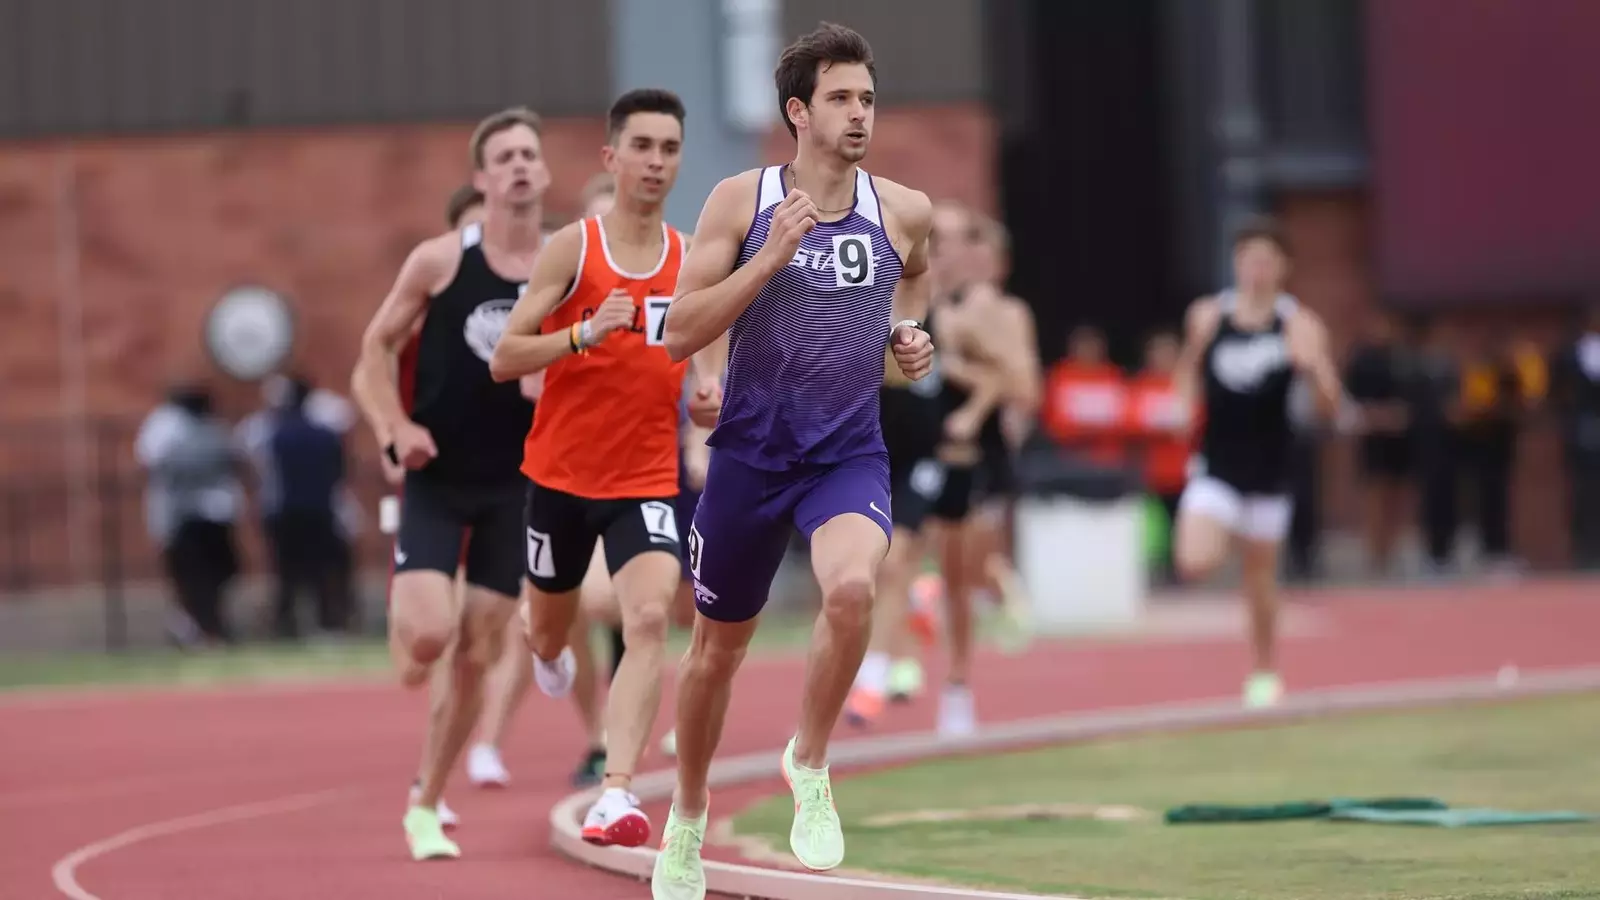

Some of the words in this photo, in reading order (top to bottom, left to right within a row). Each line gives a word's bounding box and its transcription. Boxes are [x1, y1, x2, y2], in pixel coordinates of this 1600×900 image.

[838, 238, 868, 284] 9
[650, 302, 671, 341] 7
[646, 505, 667, 530] 7
[530, 535, 544, 571] 7
[690, 527, 699, 571] 9
